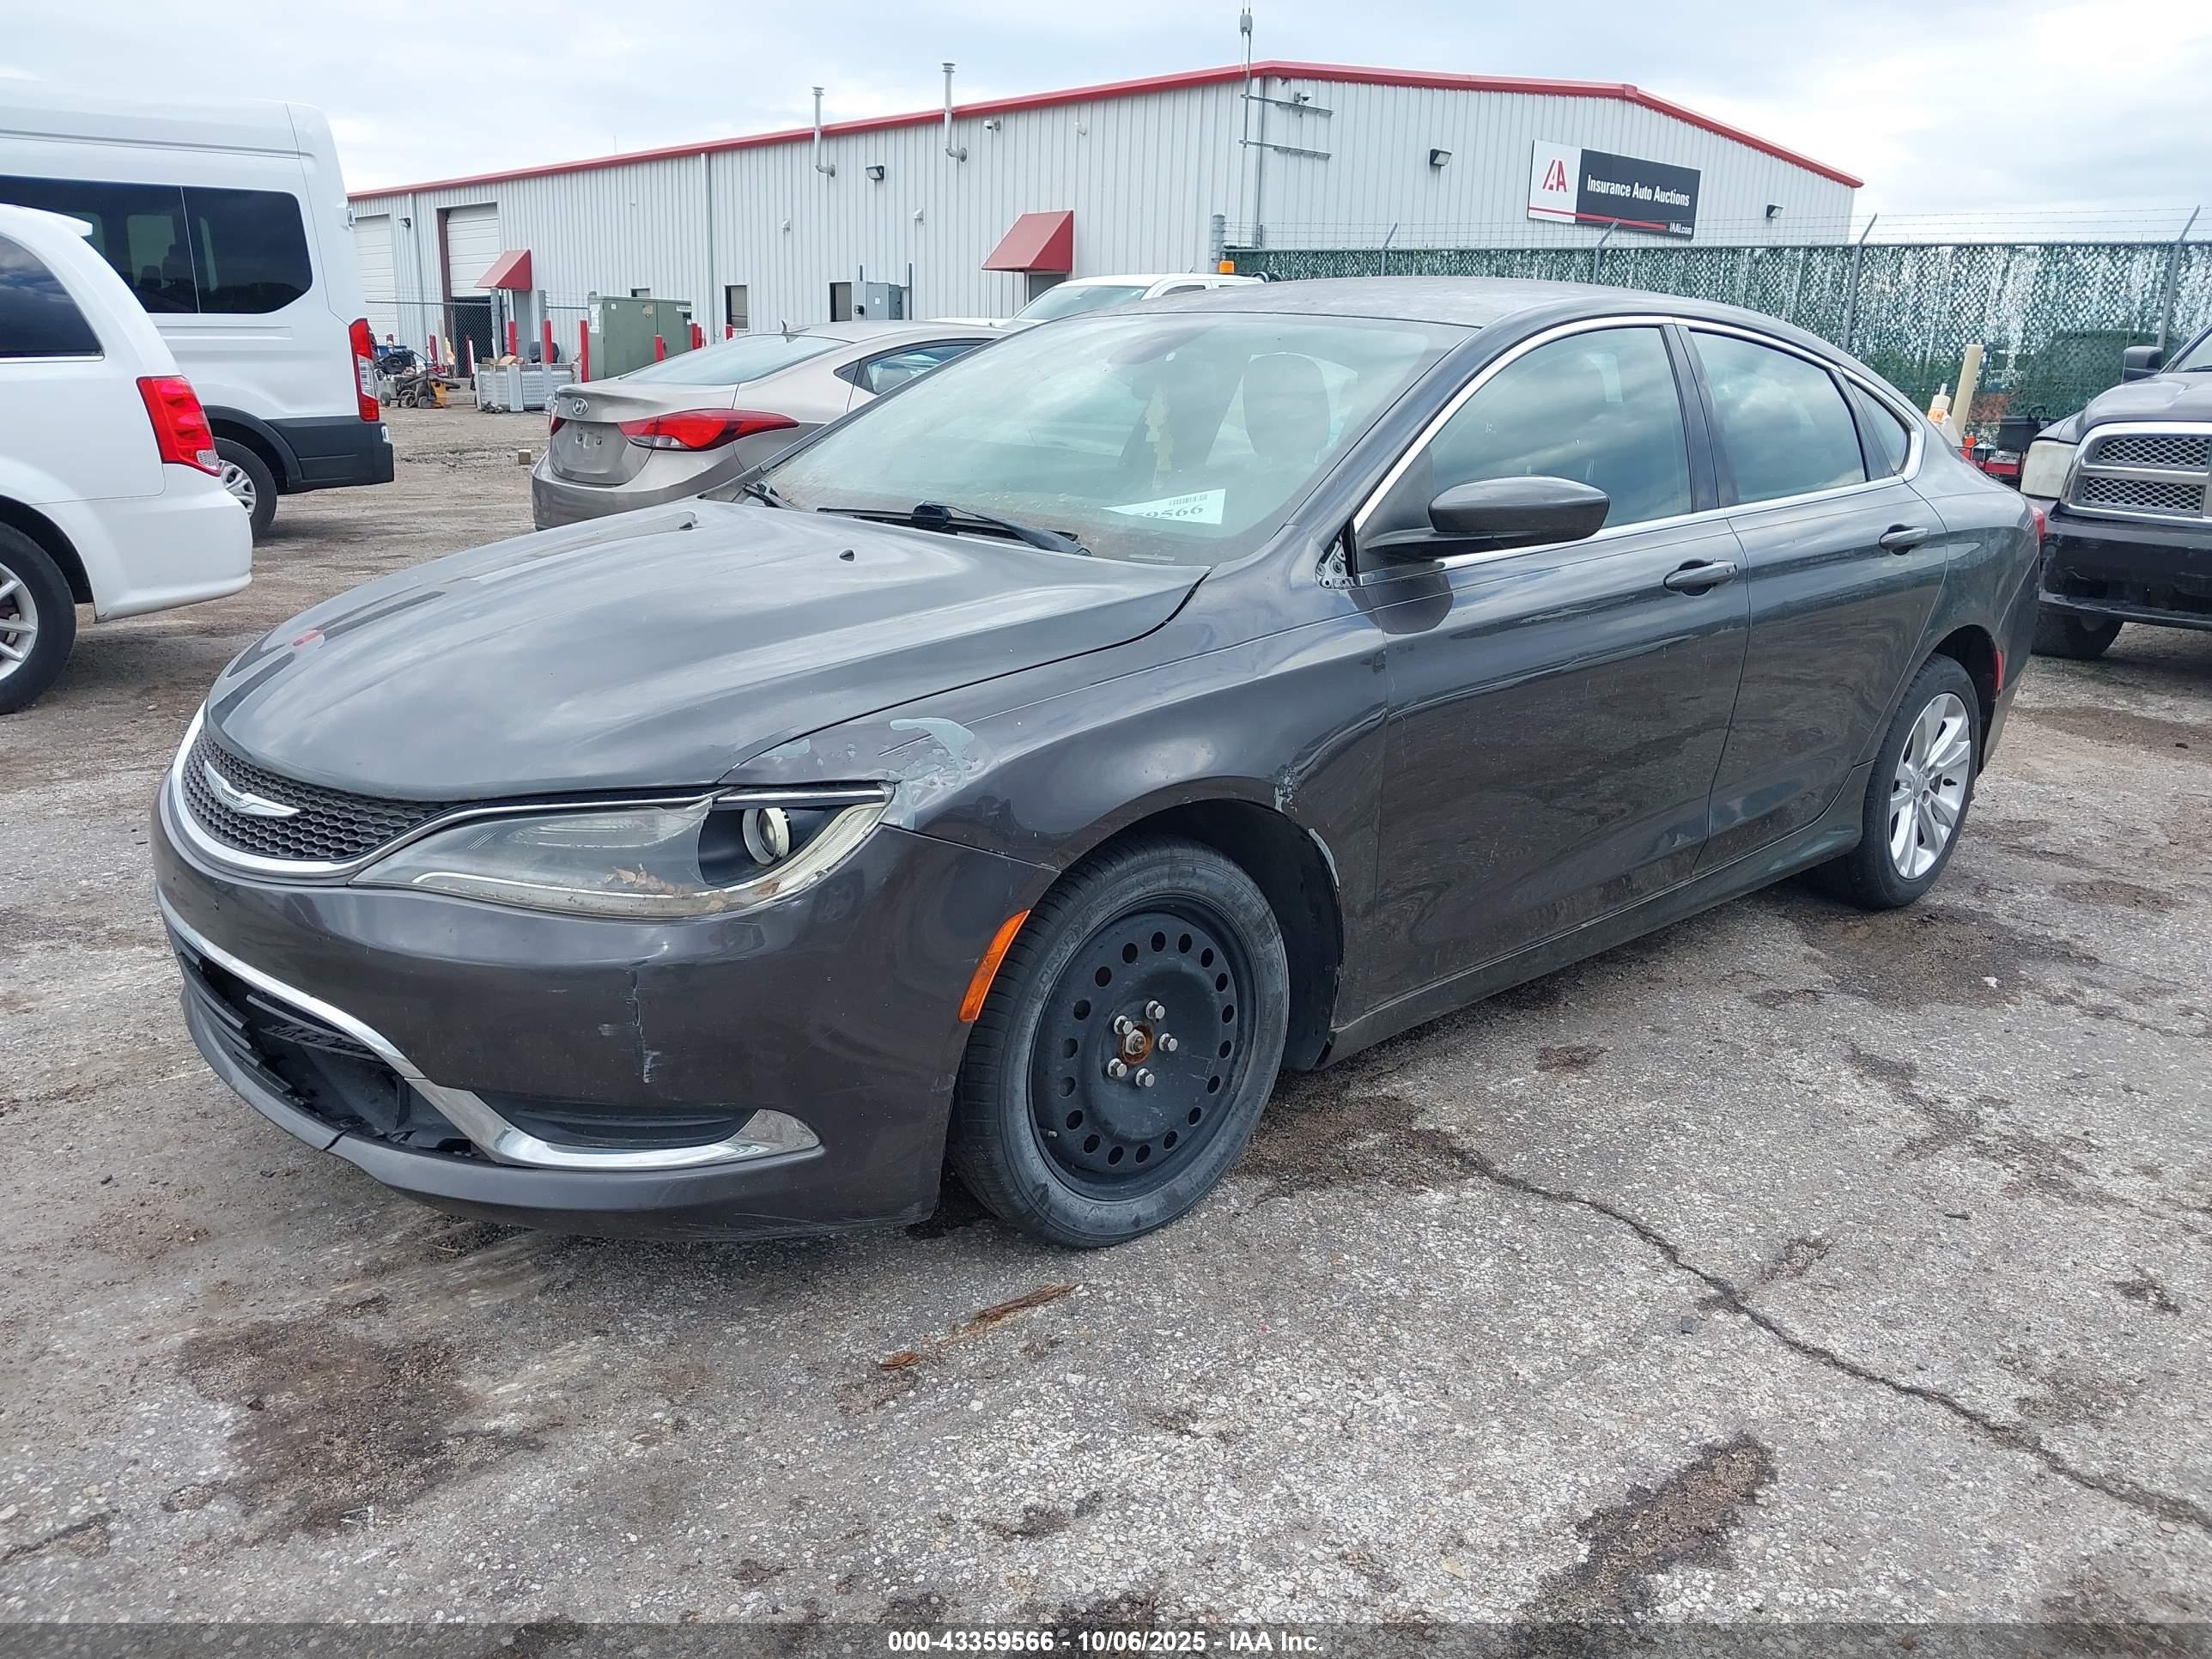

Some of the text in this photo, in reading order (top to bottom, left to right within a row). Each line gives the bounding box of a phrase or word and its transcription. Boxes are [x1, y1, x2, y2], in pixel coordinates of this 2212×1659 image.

[1587, 174, 1690, 206] Insurance Auto Auctions
